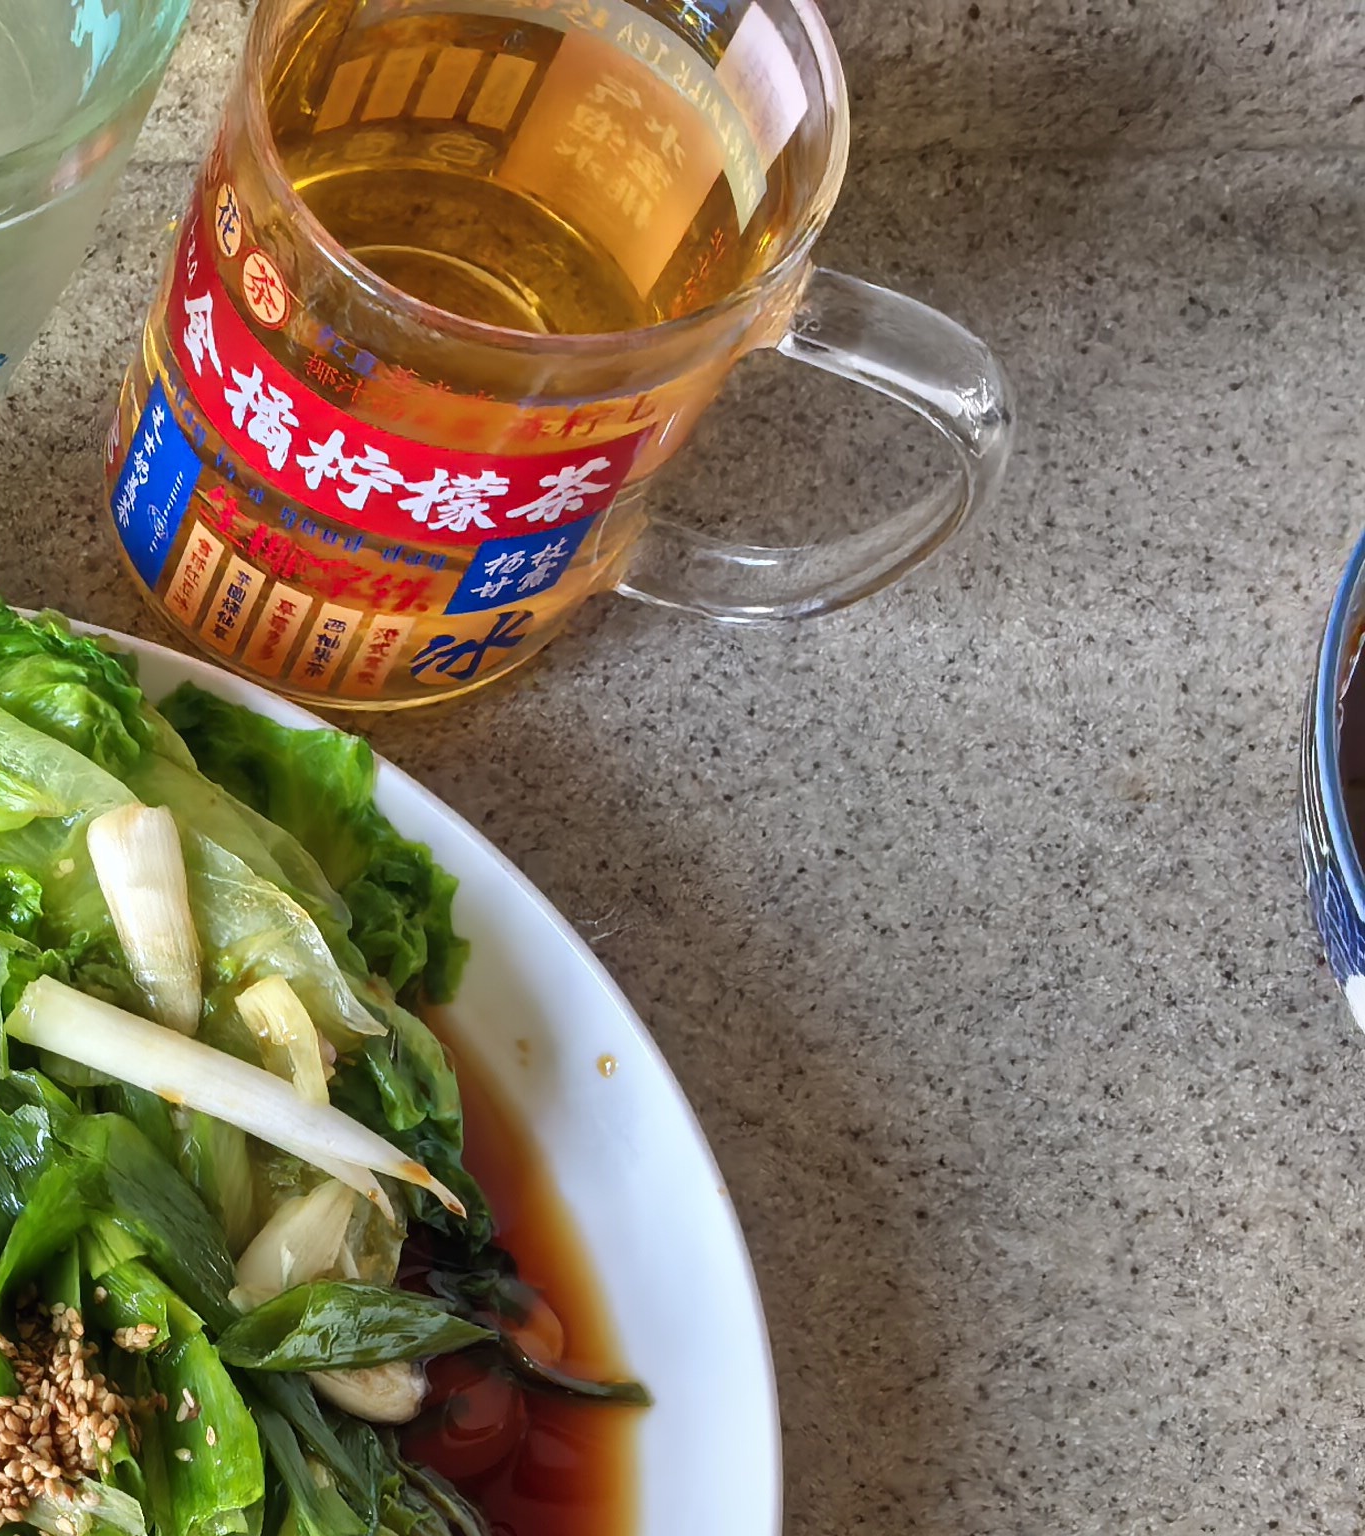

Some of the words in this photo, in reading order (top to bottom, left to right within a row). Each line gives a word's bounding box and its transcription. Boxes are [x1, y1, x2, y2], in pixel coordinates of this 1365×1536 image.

[243, 252, 286, 320] 茶
[280, 507, 364, 553] good
[409, 610, 536, 680] 冰
